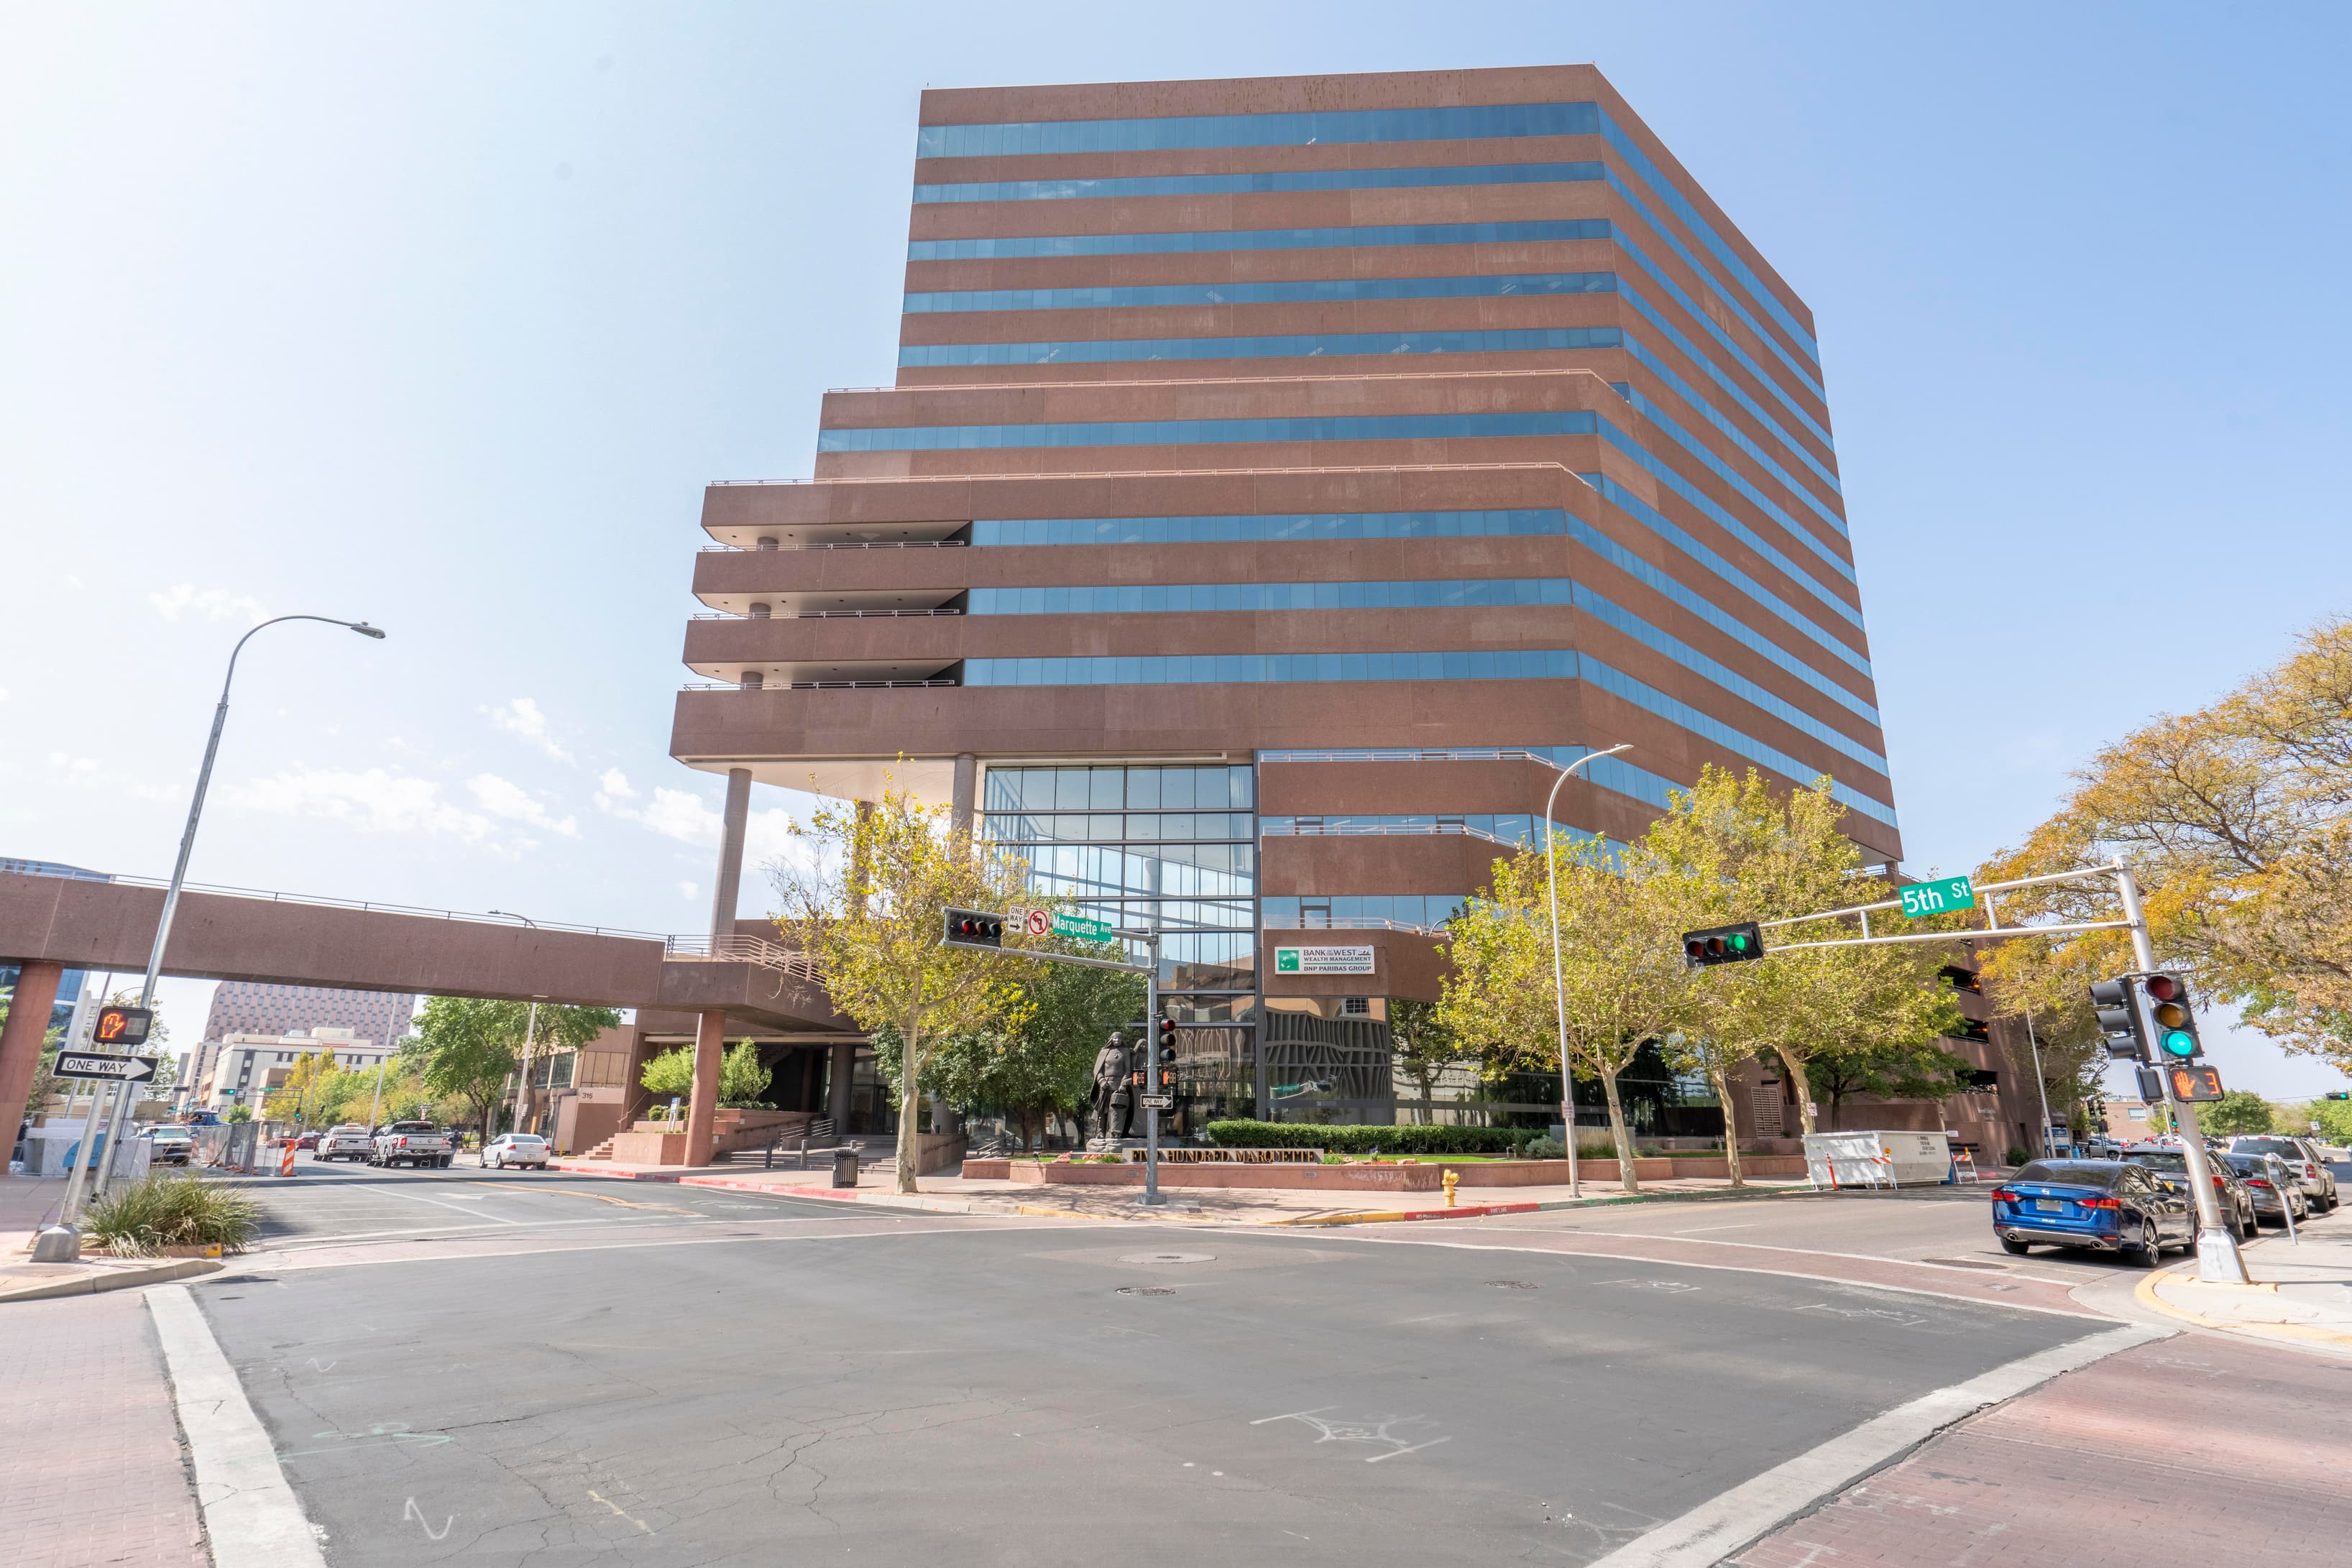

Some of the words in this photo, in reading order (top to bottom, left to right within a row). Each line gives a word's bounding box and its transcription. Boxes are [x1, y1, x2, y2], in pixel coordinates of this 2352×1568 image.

[1903, 887, 1944, 913] 5th
[1951, 882, 1970, 898] St
[1053, 914, 1097, 936] Marquette
[1100, 924, 1111, 934] Ave
[66, 1059, 94, 1071] ONE
[98, 1061, 127, 1073] WAY
[2205, 1072, 2220, 1095] 3
[1132, 1150, 1161, 1162] FI
[1167, 1150, 1231, 1162] HUNDRED
[1236, 1150, 1315, 1163] MARQUETTE
